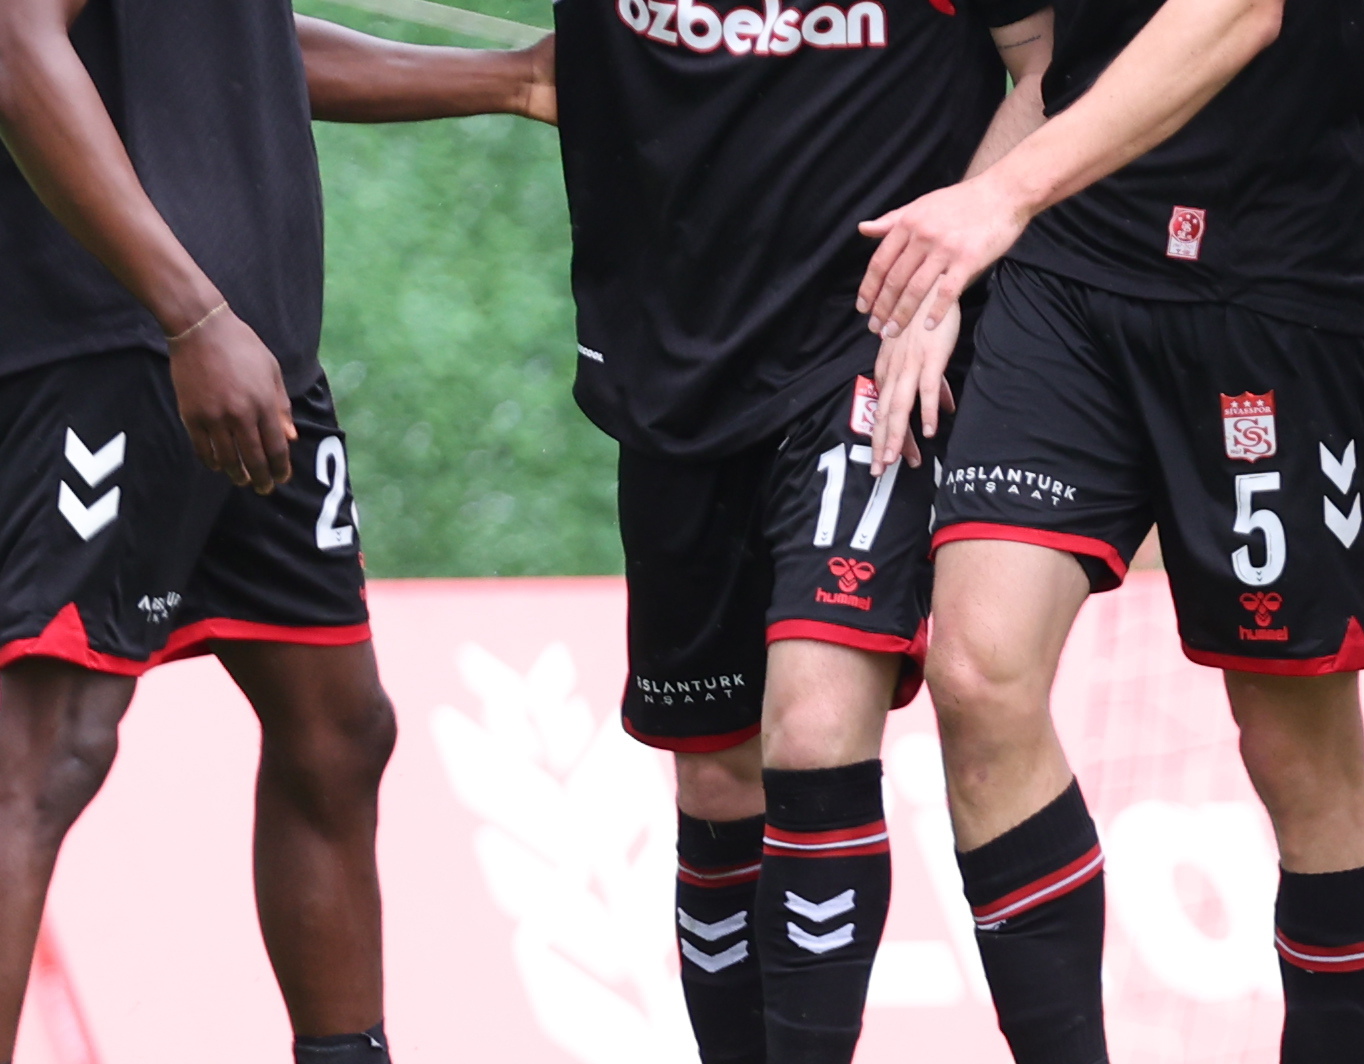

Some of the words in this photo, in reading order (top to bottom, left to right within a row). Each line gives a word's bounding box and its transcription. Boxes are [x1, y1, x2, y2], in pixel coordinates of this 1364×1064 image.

[315, 435, 359, 551] 2
[813, 442, 902, 551] 17
[1231, 471, 1287, 587] 5
[815, 587, 872, 612] hummel
[643, 689, 733, 707] NŞAAT
